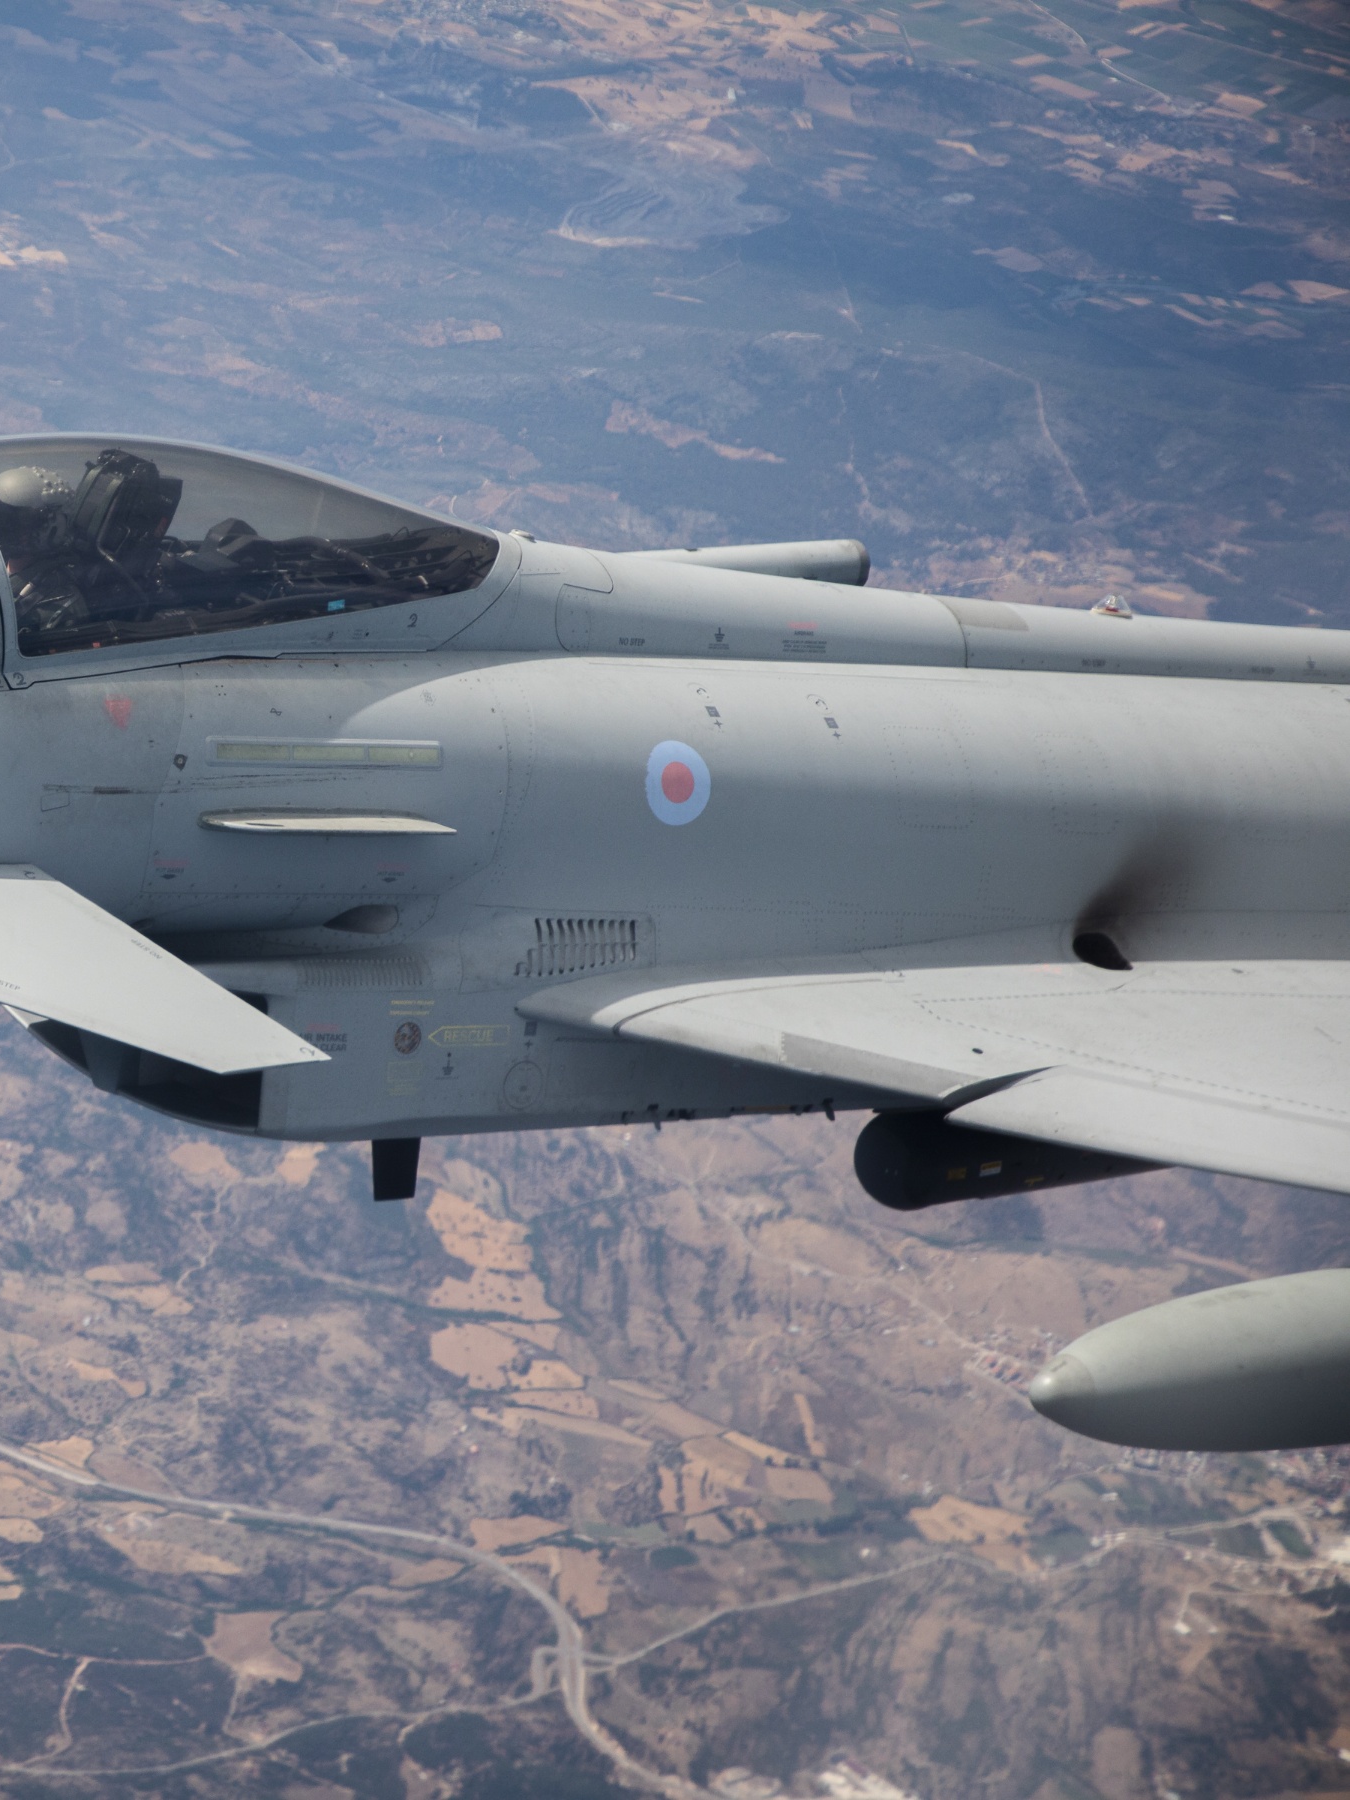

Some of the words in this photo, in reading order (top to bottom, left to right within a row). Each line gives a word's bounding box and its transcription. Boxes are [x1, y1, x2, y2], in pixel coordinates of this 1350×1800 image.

[618, 636, 629, 646] NO
[629, 637, 646, 647] STEP
[316, 1032, 348, 1043] INTAKE
[443, 1029, 494, 1043] RESCUE
[320, 1043, 348, 1052] CLEAR
